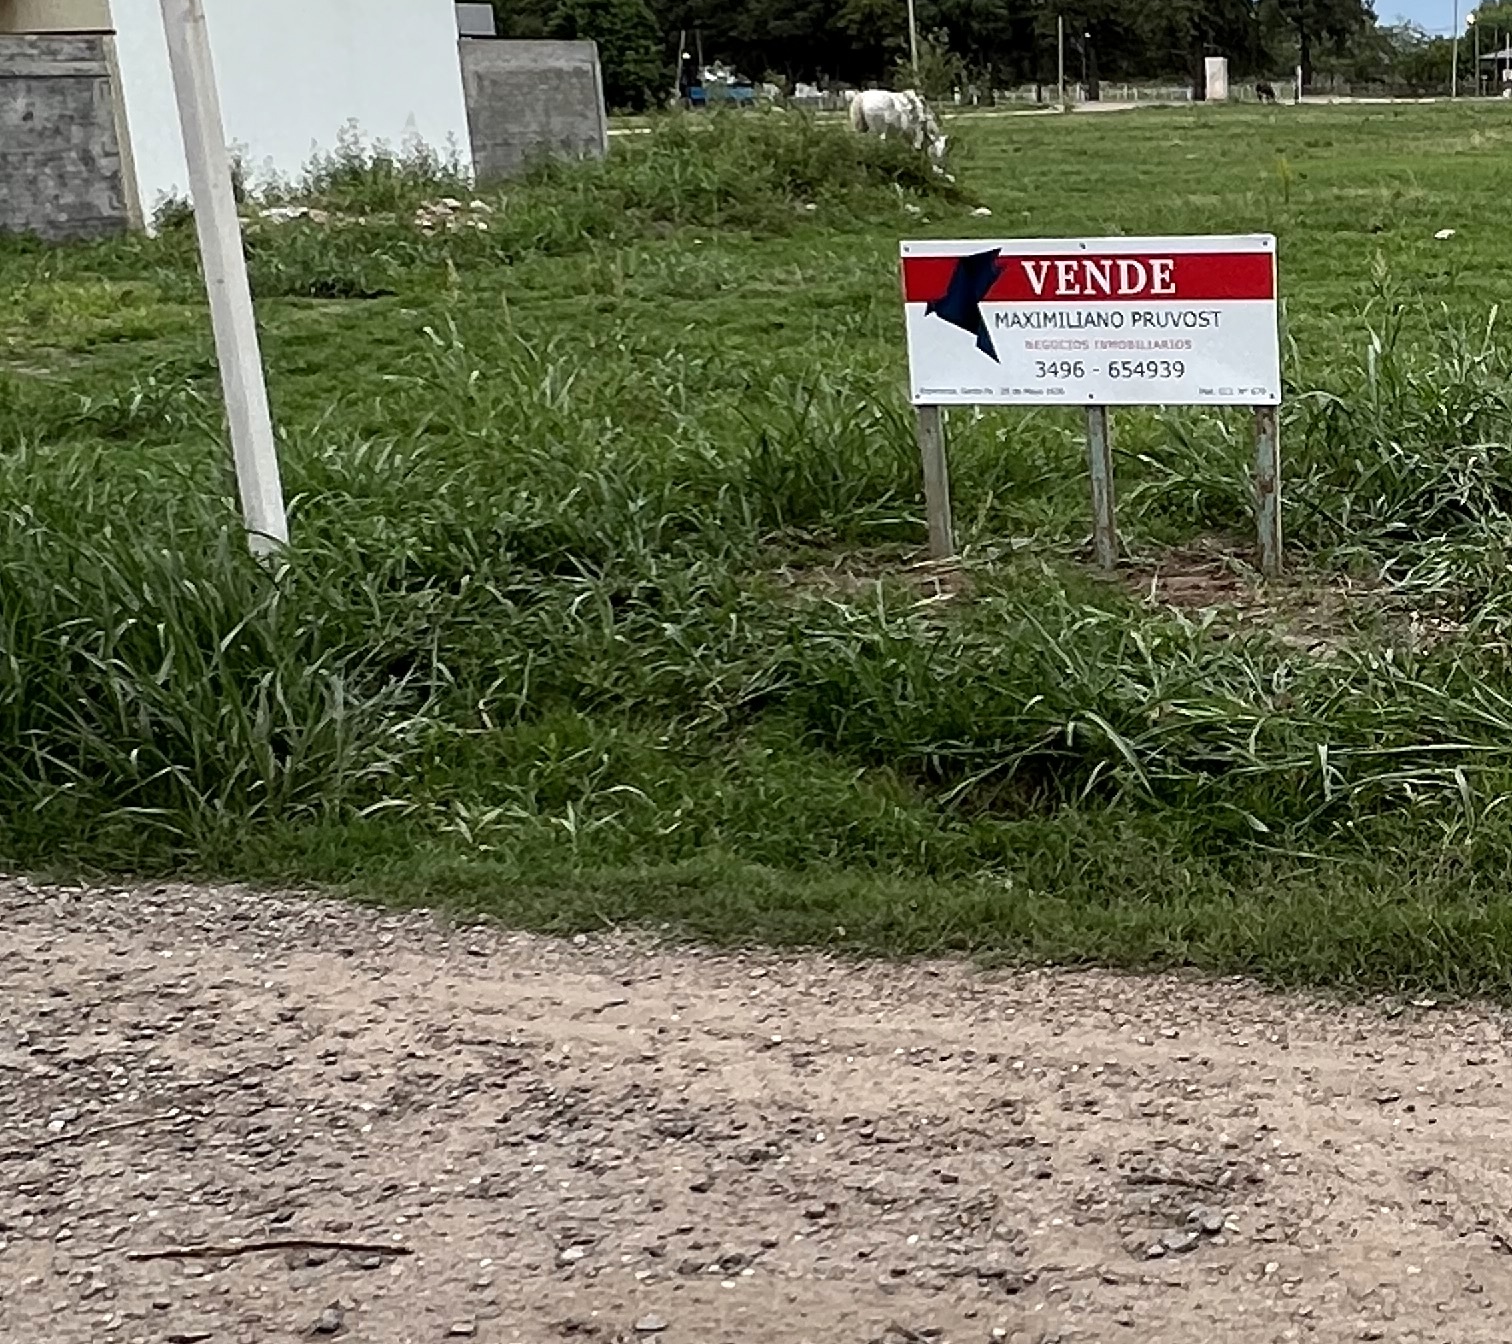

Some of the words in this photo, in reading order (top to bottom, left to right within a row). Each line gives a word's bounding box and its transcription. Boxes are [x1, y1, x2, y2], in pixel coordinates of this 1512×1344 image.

[1021, 259, 1176, 296] VENDE
[994, 311, 1124, 329] MAXIMILIANO
[1131, 310, 1222, 328] PRUVOST
[1024, 339, 1089, 350] NEGOCIOS
[1035, 360, 1085, 379] 3496
[1108, 360, 1185, 378] 654939
